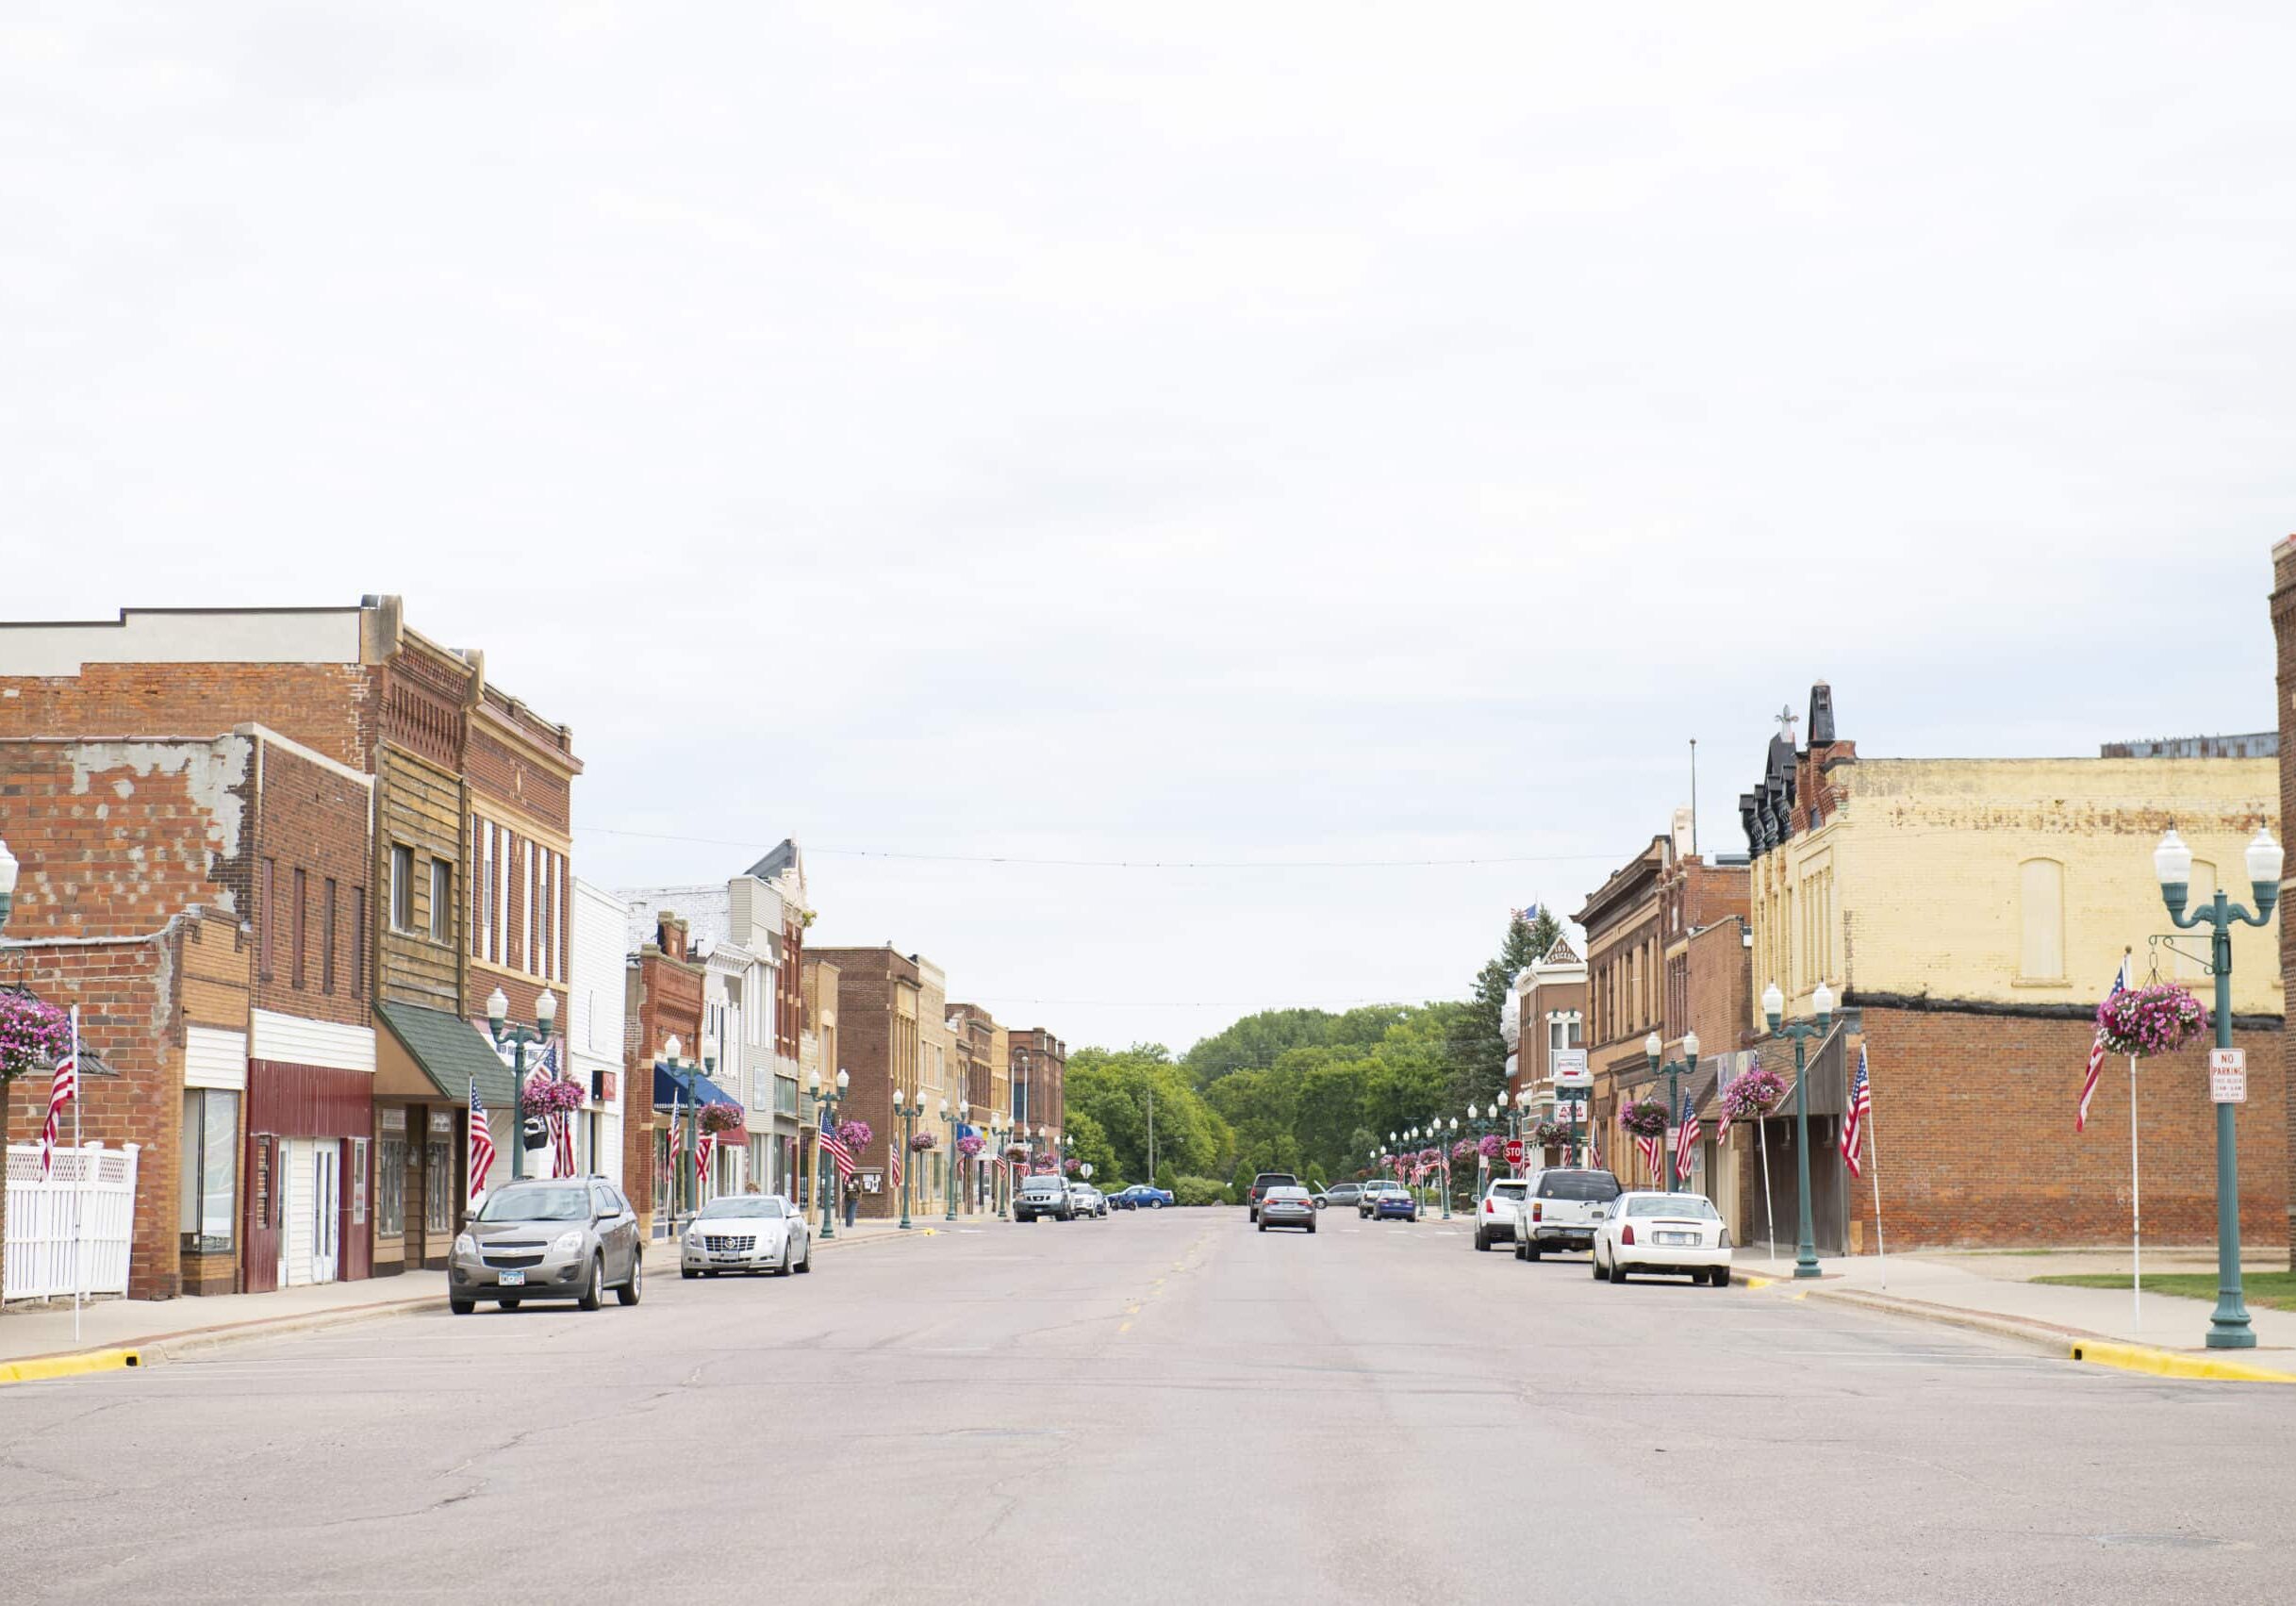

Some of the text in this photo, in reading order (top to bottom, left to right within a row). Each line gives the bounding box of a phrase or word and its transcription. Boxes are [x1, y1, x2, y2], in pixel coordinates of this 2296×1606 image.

[2222, 1053, 2234, 1064] NO
[2212, 1067, 2243, 1075] PARKING
[1506, 1147, 1521, 1157] STO
